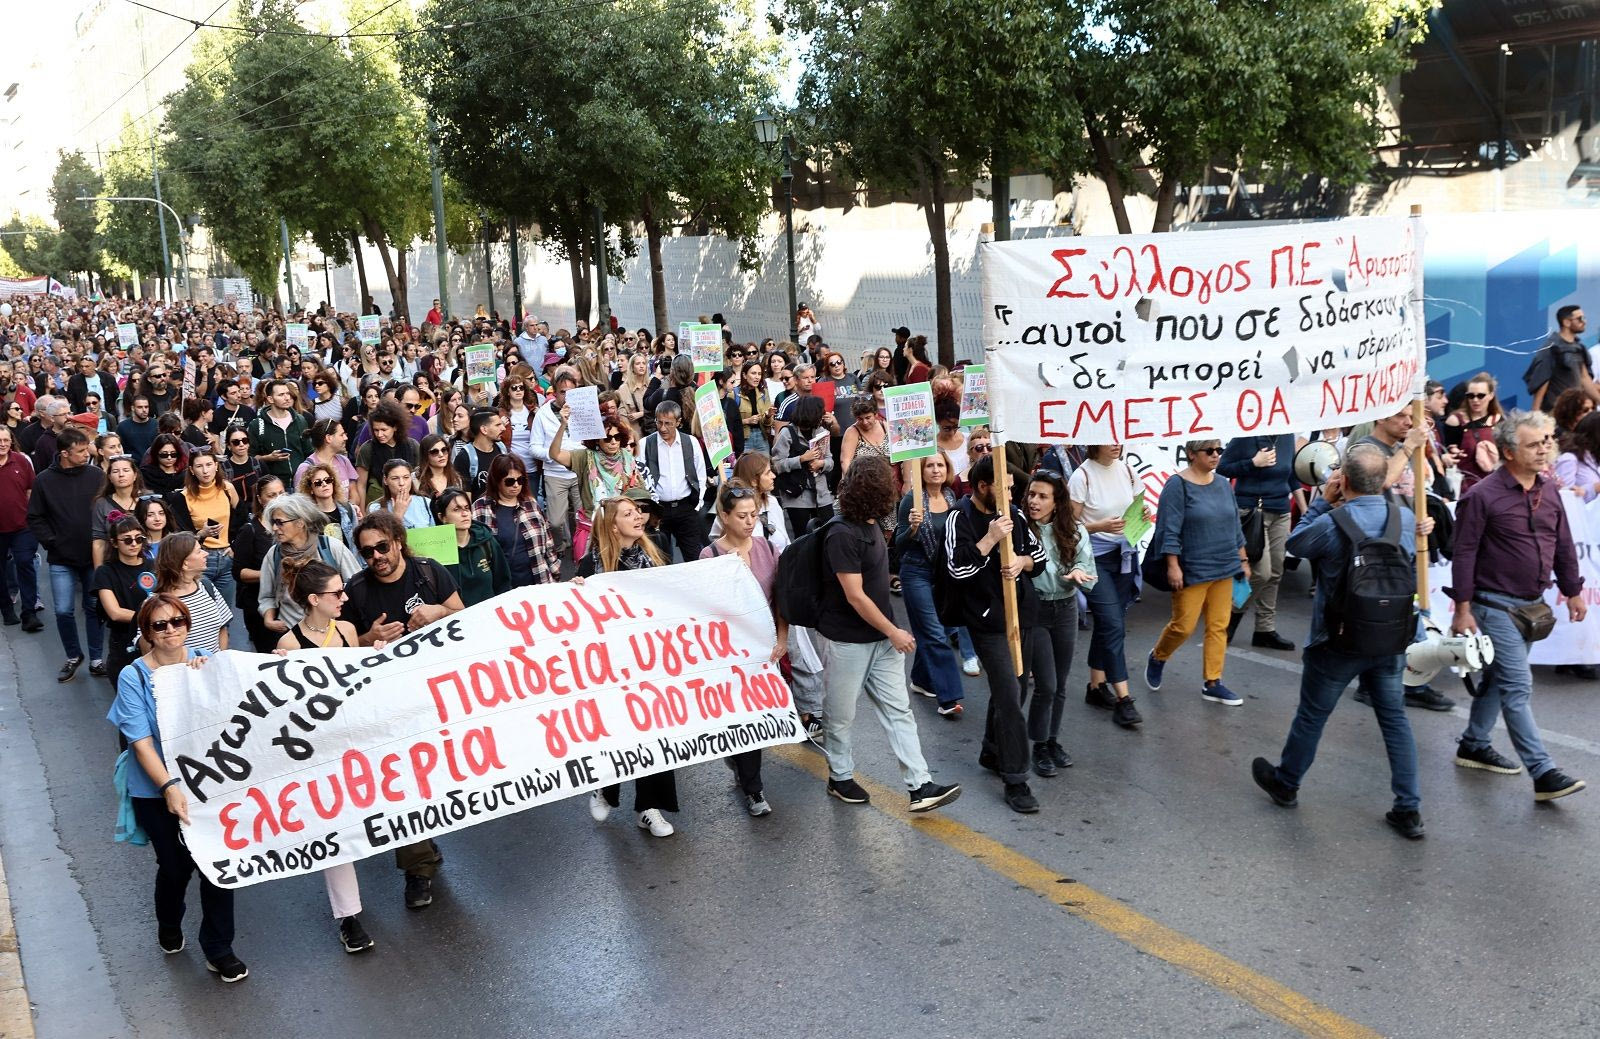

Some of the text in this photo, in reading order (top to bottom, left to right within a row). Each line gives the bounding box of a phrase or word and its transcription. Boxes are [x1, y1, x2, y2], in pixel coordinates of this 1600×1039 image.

[1046, 244, 1252, 305] Σύλλογος
[1155, 313, 1223, 342] που
[1235, 307, 1280, 342] σε
[1073, 352, 1115, 389] δε
[1143, 351, 1263, 390] μπορεί
[1307, 349, 1336, 375] να
[893, 403, 900, 412] ΤΟ
[1039, 392, 1213, 445] ΕΜΕΙΣ
[1236, 389, 1290, 431] ΘΑ
[495, 586, 654, 647] ψωμί,
[176, 619, 465, 803] Αγωνιζόμαστε
[219, 725, 506, 850] ελευθερία
[536, 697, 610, 759] για
[620, 681, 688, 733] όλο
[732, 663, 790, 713] λαό
[213, 831, 340, 885] Σύλλογος
[363, 768, 561, 848] Εκπαιδευτικών
[566, 755, 599, 788] ΠΕ
